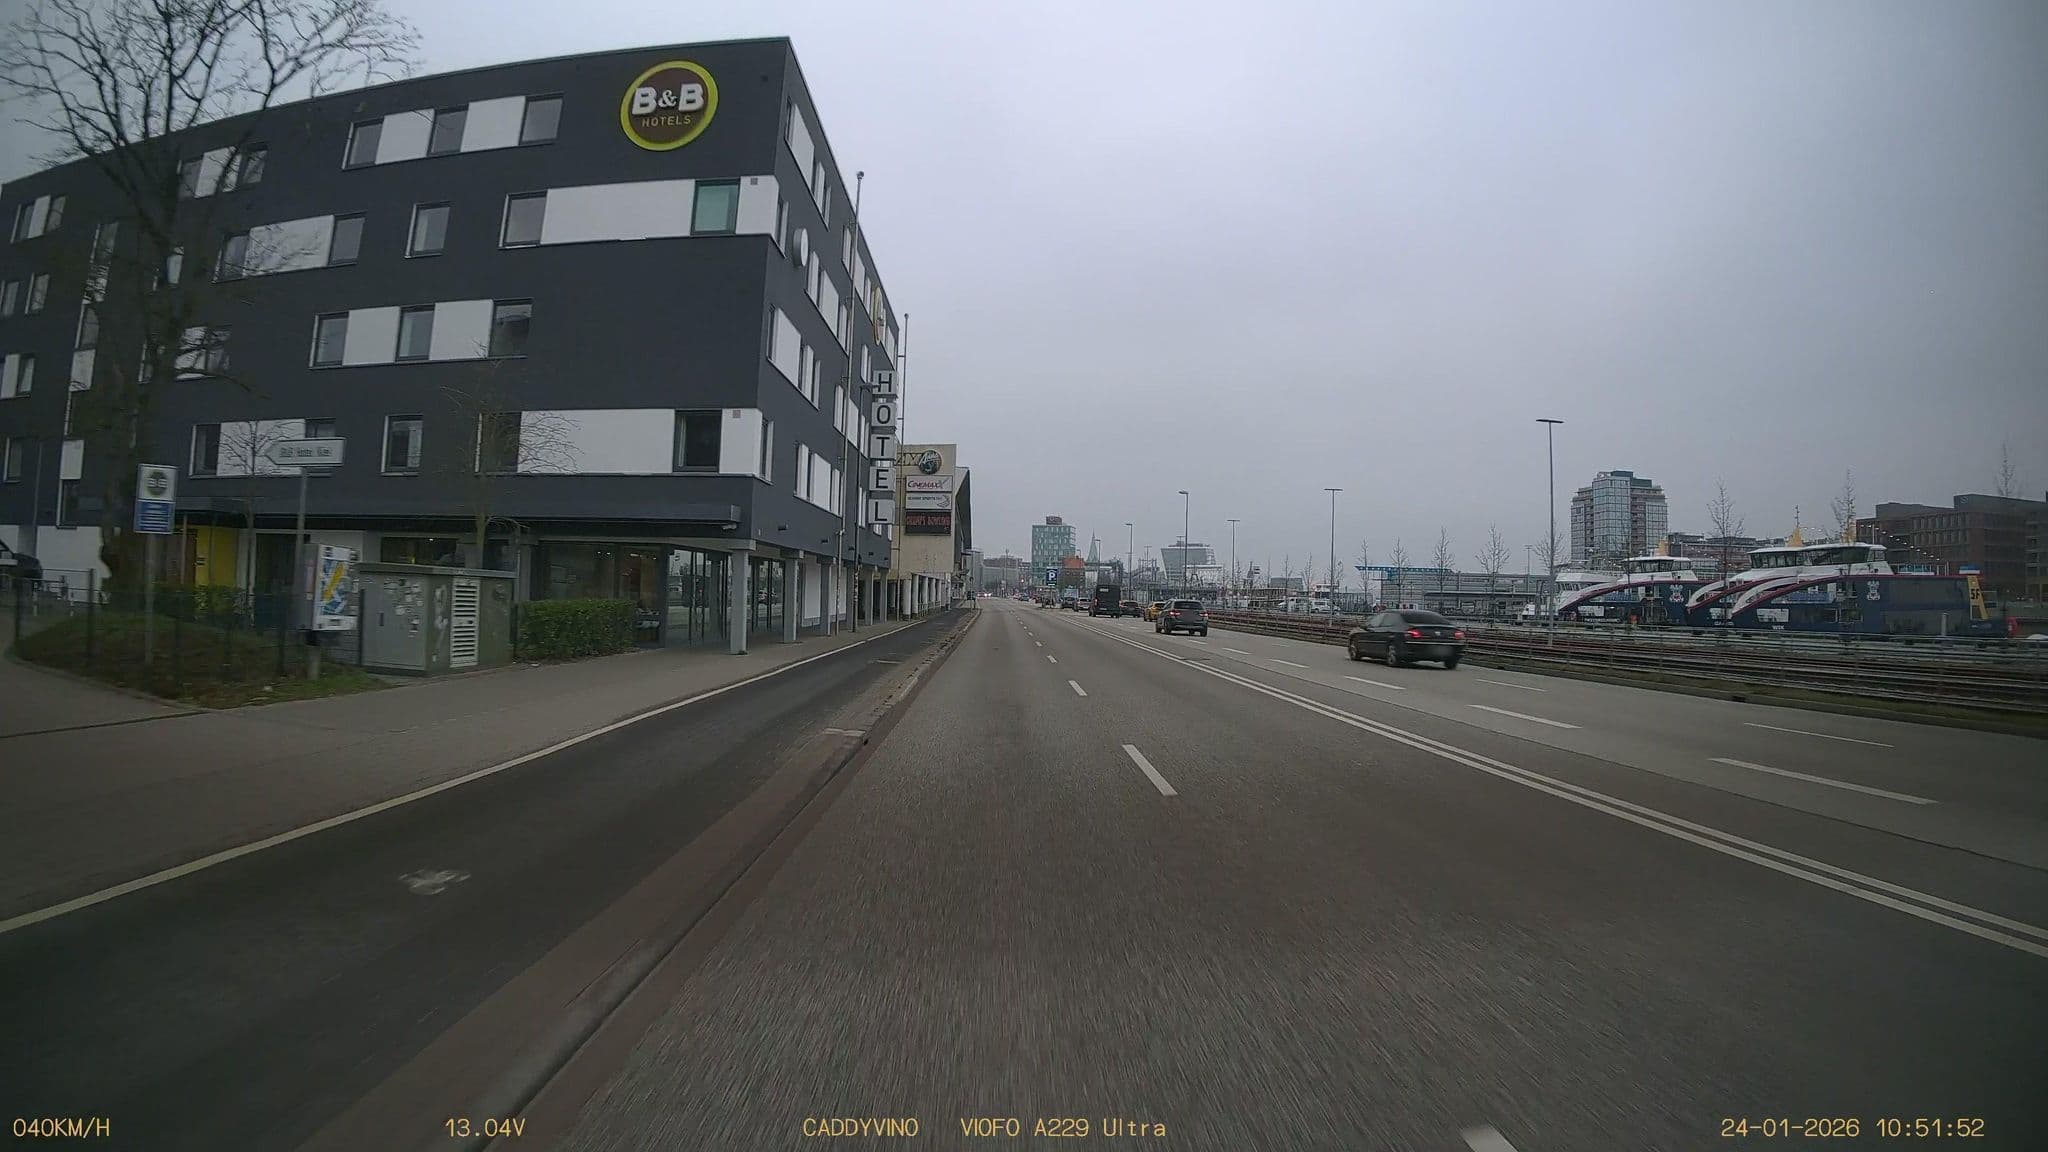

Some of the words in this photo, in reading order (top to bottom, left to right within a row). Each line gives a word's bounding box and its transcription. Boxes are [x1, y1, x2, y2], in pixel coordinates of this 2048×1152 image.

[632, 83, 704, 115] B&B
[642, 115, 691, 127] HOTELS
[874, 373, 892, 521] HOTEL
[1049, 572, 1056, 580] P
